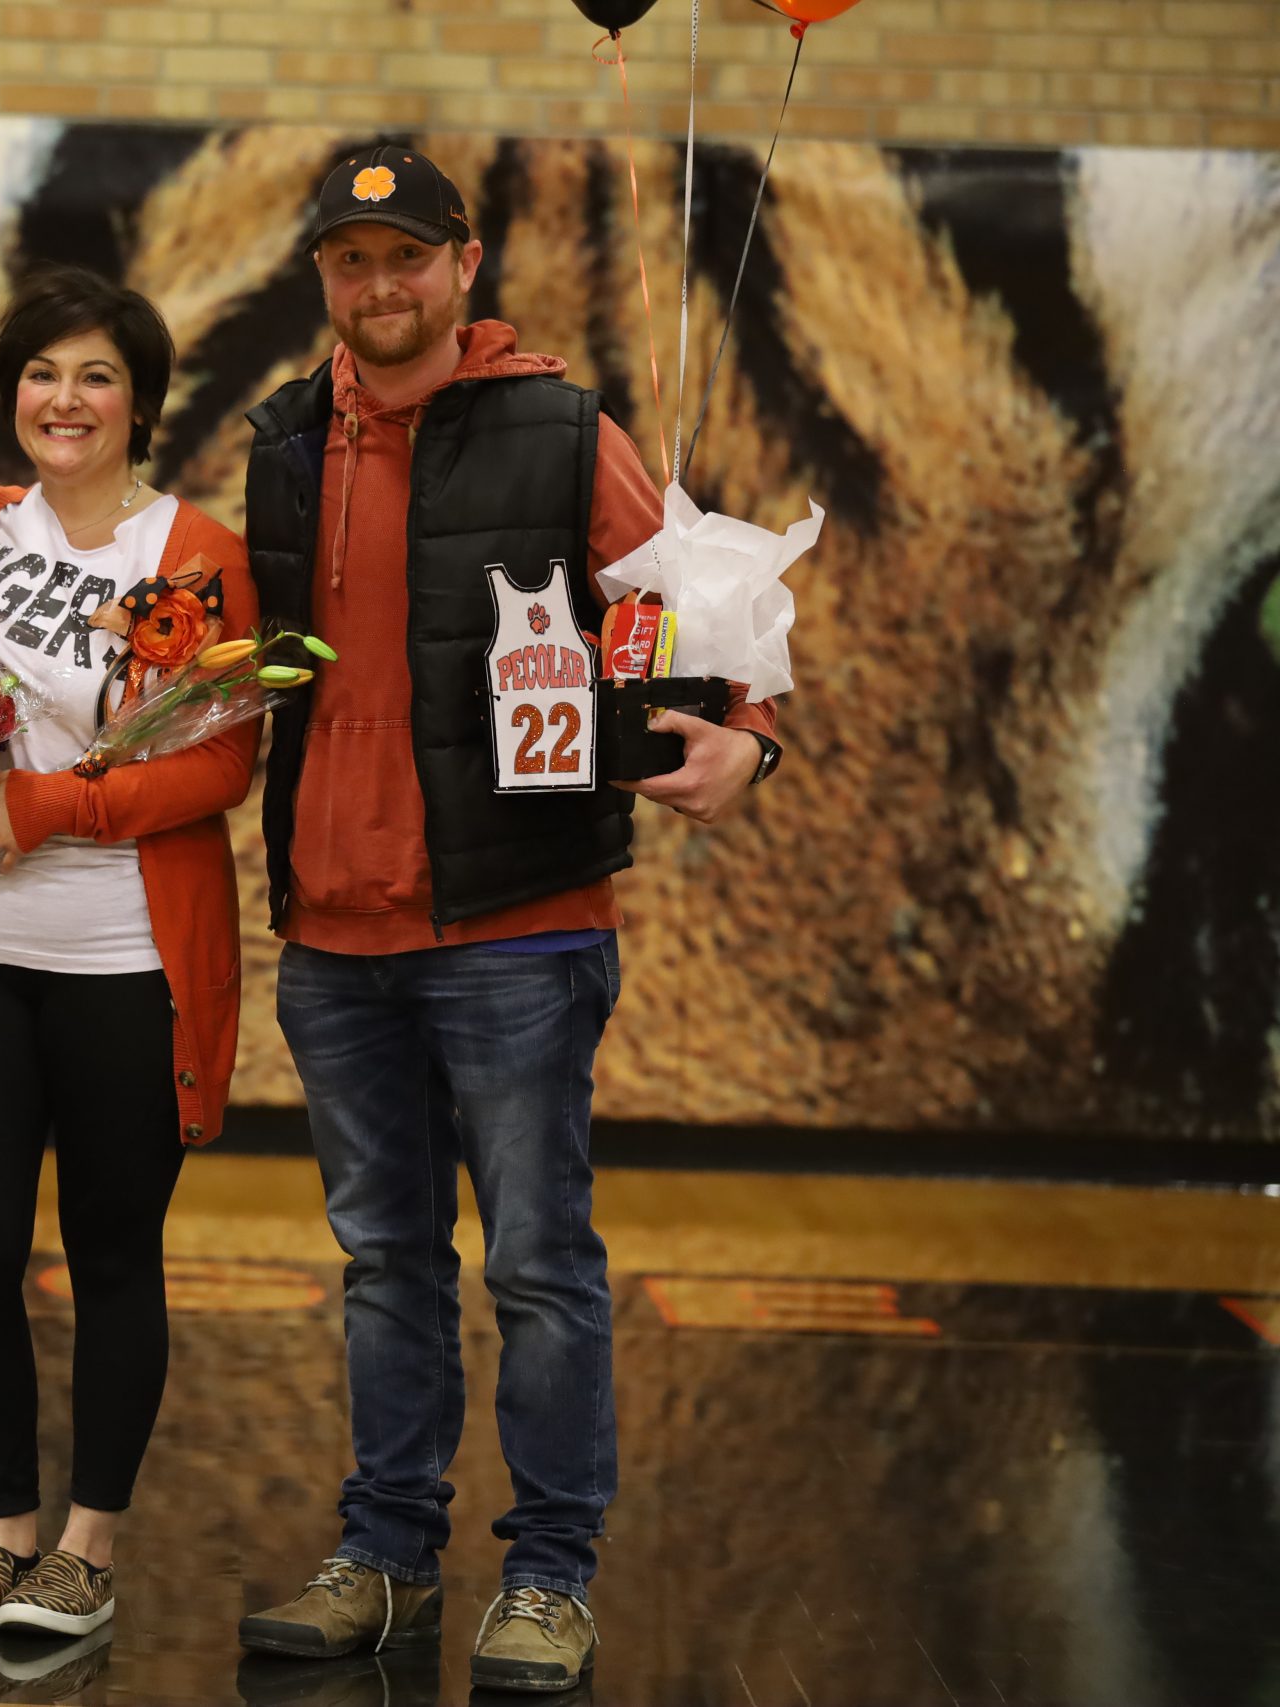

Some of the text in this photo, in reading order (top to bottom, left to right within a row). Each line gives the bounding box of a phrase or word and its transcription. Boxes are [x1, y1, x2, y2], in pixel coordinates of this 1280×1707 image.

[660, 616, 669, 650] ASSORTED
[496, 643, 587, 691] PECOLAR
[511, 701, 581, 775] 22
